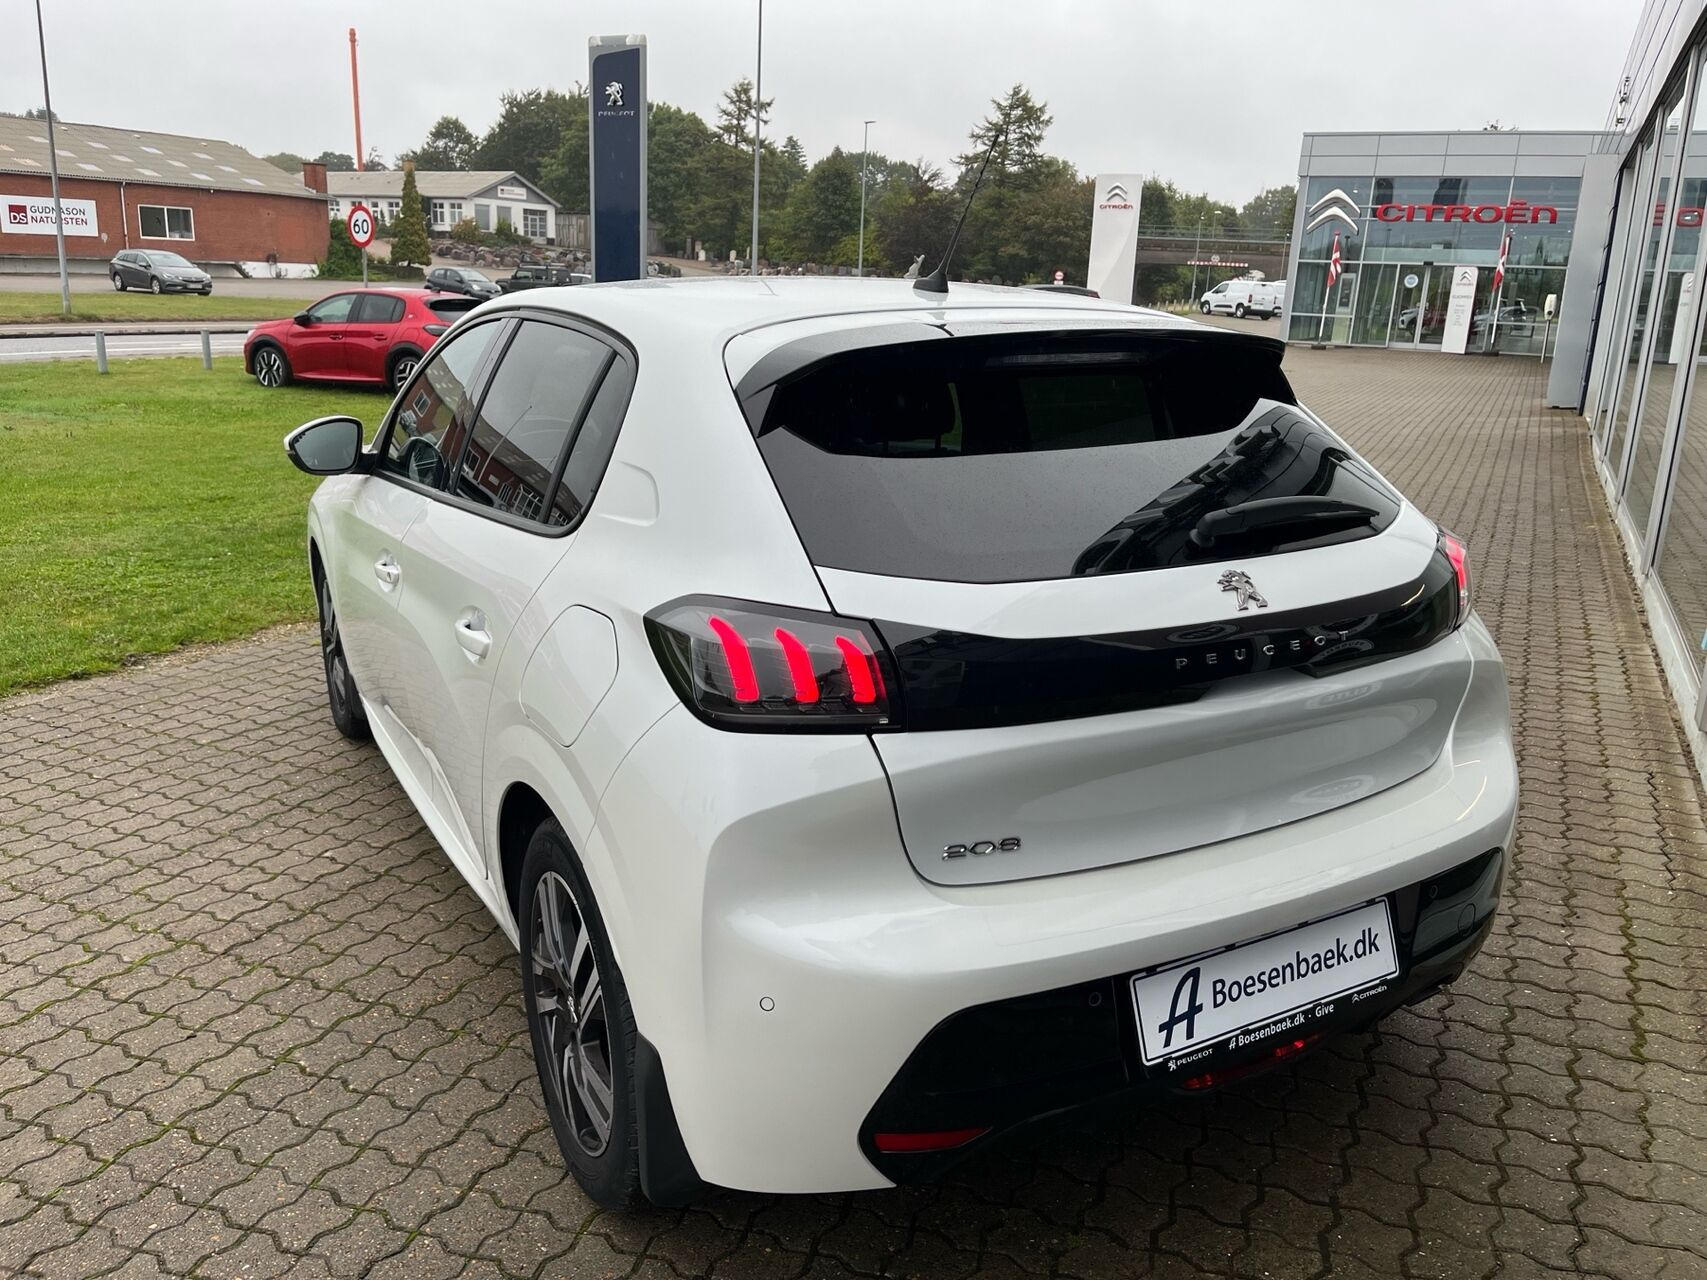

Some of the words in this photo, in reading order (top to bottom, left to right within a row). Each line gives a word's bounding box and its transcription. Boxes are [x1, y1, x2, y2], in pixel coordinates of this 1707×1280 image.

[10, 212, 27, 223] DS
[31, 216, 88, 226] NATUSTEN
[353, 219, 369, 234] 60
[1175, 630, 1349, 672] PEUGEOT
[942, 837, 1021, 860] 208
[1212, 927, 1381, 1009] Boesenbaek.dk
[1237, 1012, 1306, 1047] Boesenbaek.dk
[1315, 1002, 1335, 1018] Give
[1176, 1048, 1214, 1066] PEUGEOT
